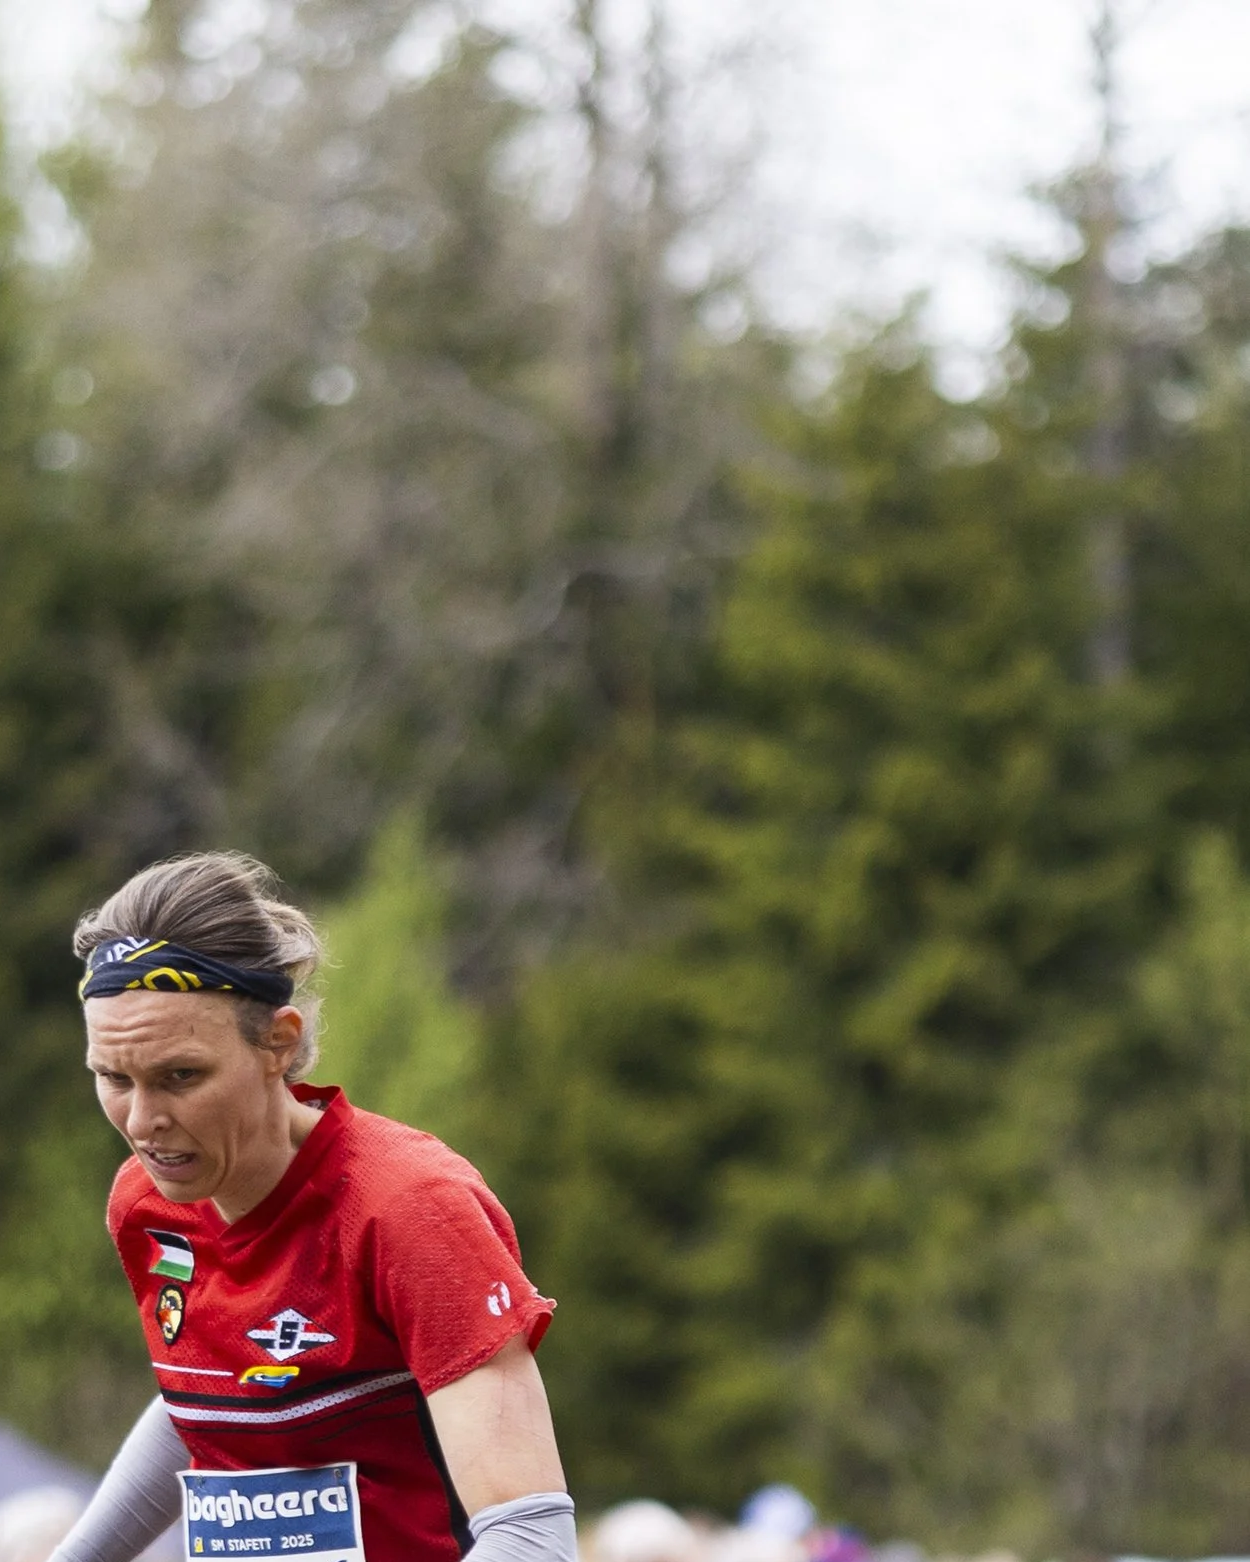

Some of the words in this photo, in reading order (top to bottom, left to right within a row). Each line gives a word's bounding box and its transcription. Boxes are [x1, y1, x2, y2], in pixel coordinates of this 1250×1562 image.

[188, 1485, 348, 1527] bagheera
[211, 1538, 226, 1552] SM
[228, 1537, 272, 1551] STAFETT
[281, 1534, 315, 1550] 2025
